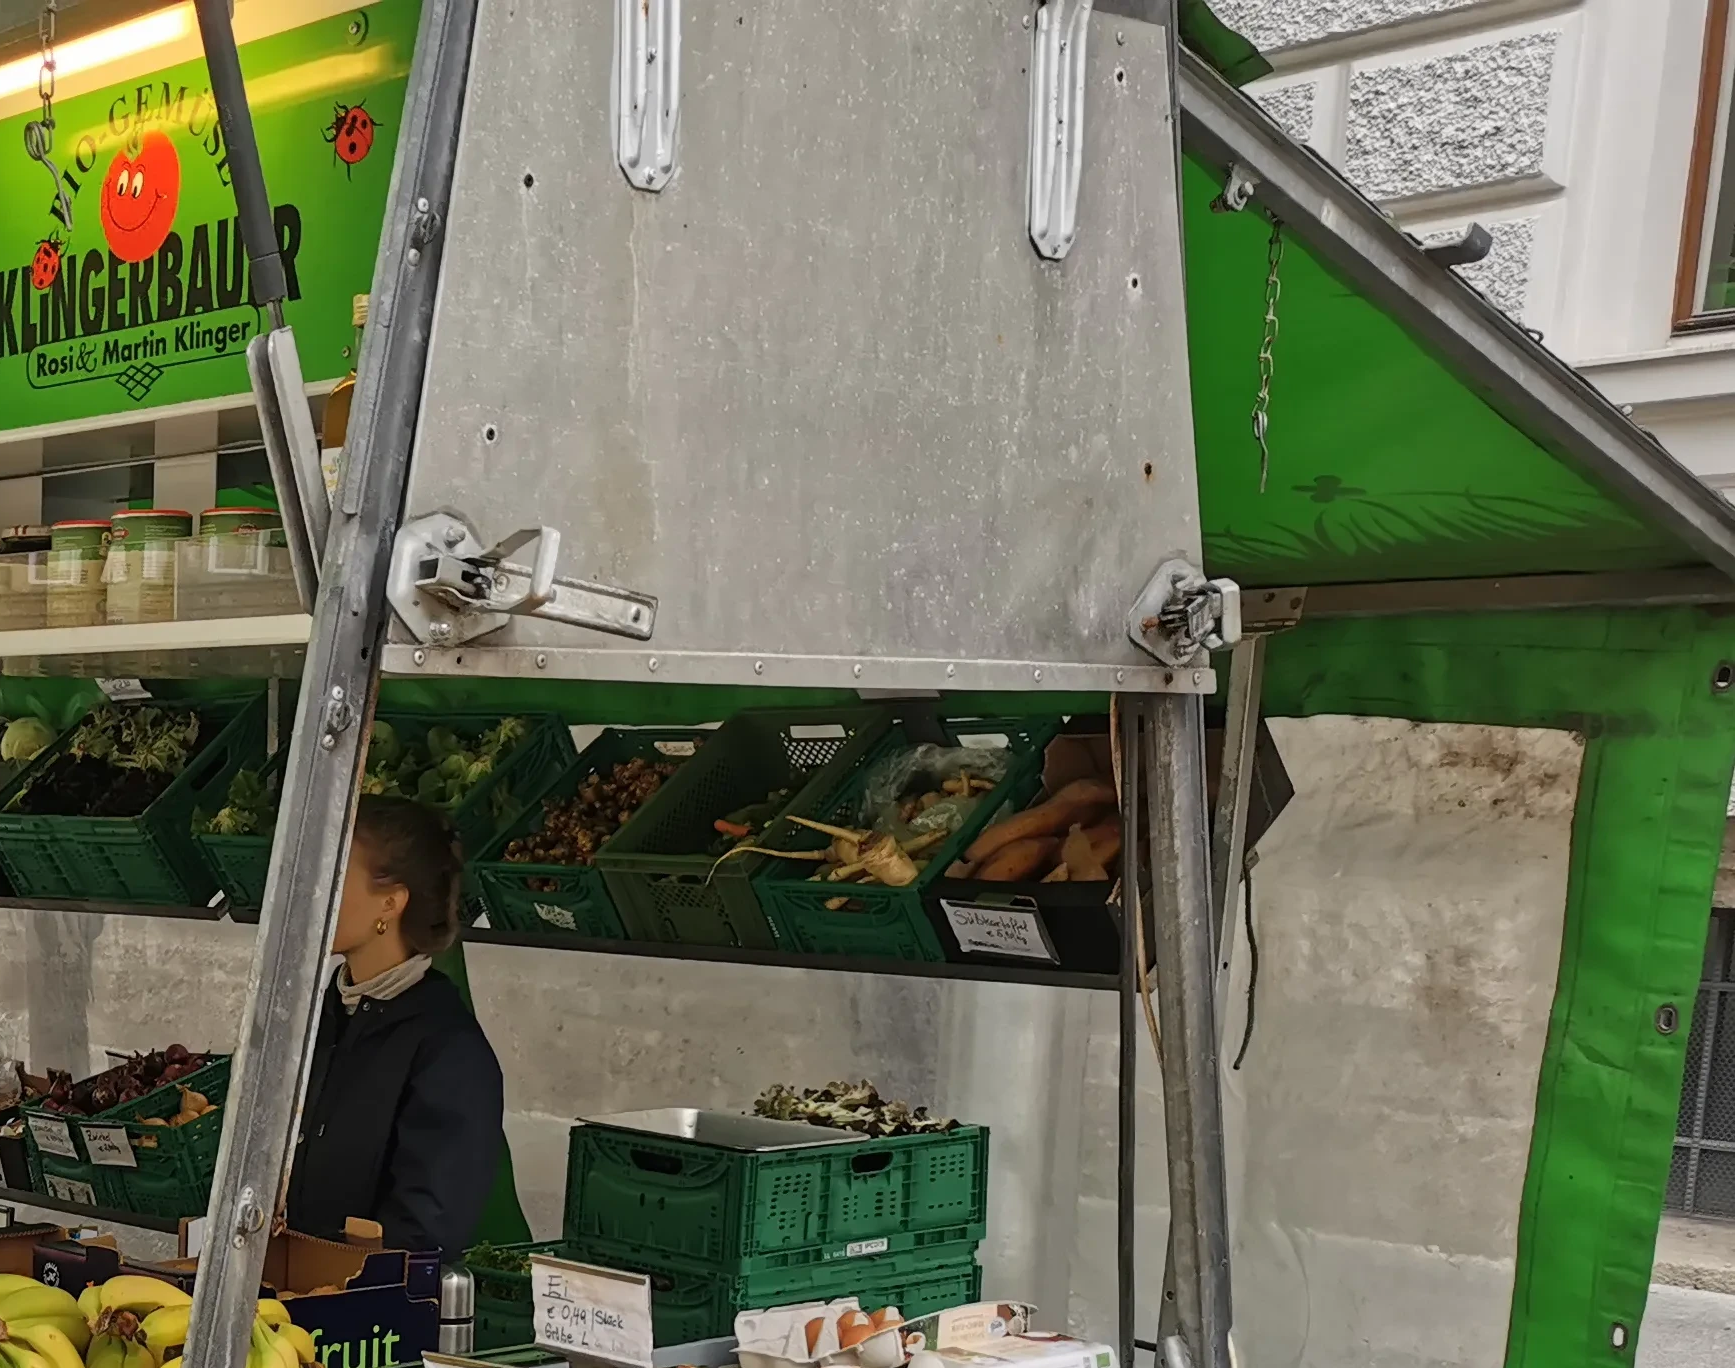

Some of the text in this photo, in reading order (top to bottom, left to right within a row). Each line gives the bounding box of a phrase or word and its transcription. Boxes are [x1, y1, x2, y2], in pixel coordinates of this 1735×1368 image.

[36, 318, 252, 379] Rosi & Martin Klinger
[547, 1274, 569, 1298] Ei
[547, 1306, 556, 1319] €
[581, 1331, 589, 1346] L
